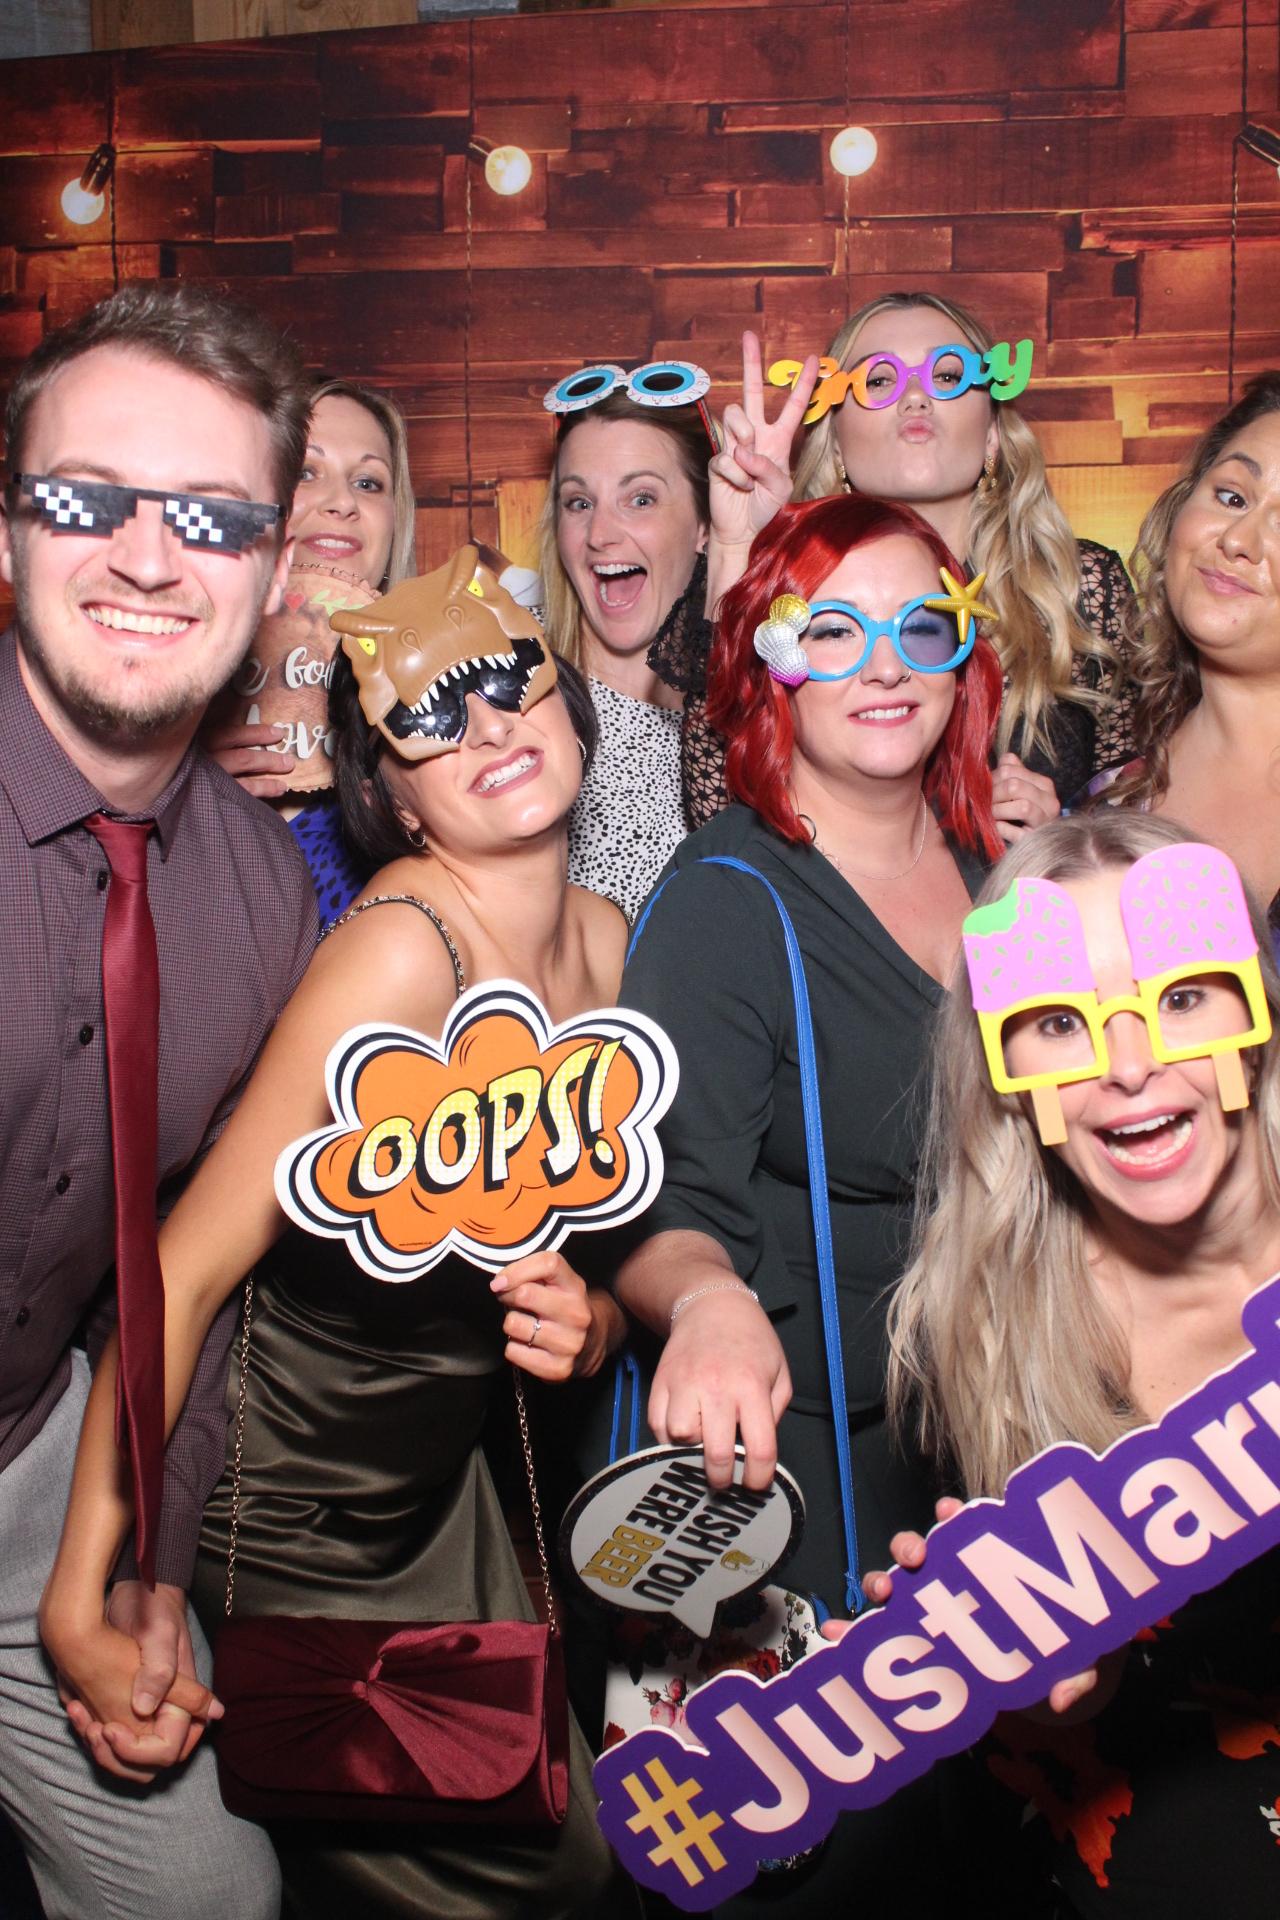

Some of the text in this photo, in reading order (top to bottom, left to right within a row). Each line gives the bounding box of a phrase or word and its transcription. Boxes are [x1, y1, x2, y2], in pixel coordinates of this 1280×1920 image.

[768, 339, 1034, 424] Groovy
[347, 1035, 626, 1198] OOPS!
[579, 1461, 707, 1588] WERE BEER
[633, 1484, 776, 1606] WISH YOU
